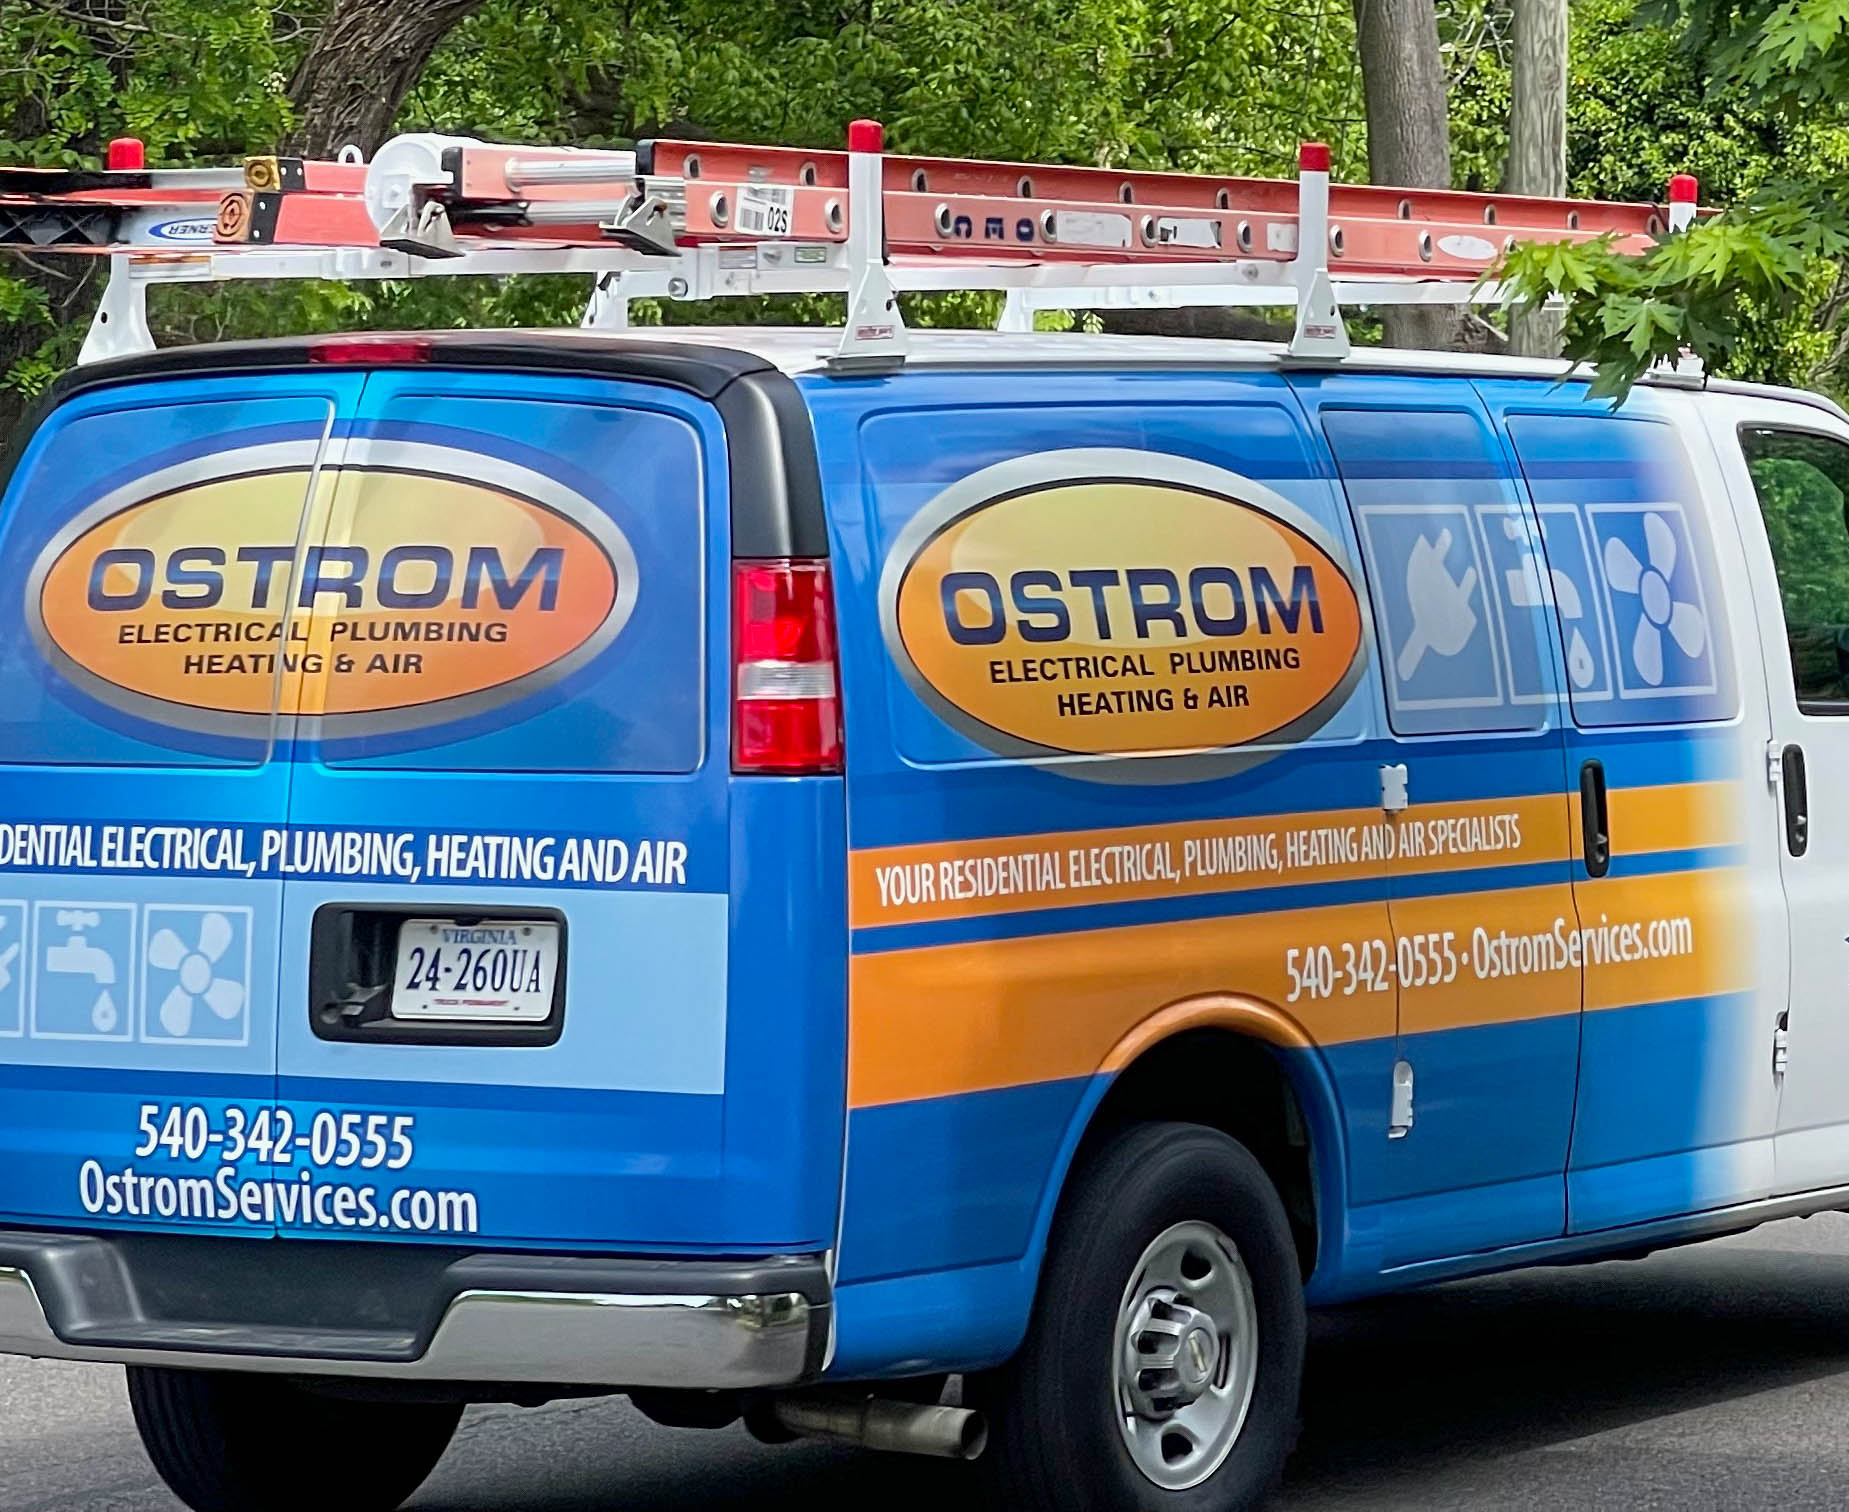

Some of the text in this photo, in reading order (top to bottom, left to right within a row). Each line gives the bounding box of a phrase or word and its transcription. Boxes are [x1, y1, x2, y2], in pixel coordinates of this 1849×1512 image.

[168, 224, 217, 235] RNER
[87, 546, 564, 612] OSTROM
[940, 566, 1324, 645] OSTROM
[118, 621, 509, 644] ELECTRICAL PLUMBING
[184, 654, 424, 675] HEATING & AIR
[989, 648, 1301, 684] ELECTRICAL PLUMBING
[1057, 685, 1250, 717] HEATING & AIR
[0, 823, 688, 885] DENTIAL ELECTRICAL, PLUMBING, HEATING AND AIR
[875, 813, 1521, 907] YOUR RESIDENTIAL ELECTRICAL, PLUMBING, HEATING AND AIR SPECIALISTS
[442, 928, 517, 945] VIRGINIA
[406, 946, 541, 993] 24-260UA
[135, 1104, 415, 1169] 540-342-0555
[79, 1159, 479, 1233] OstromServices.com
